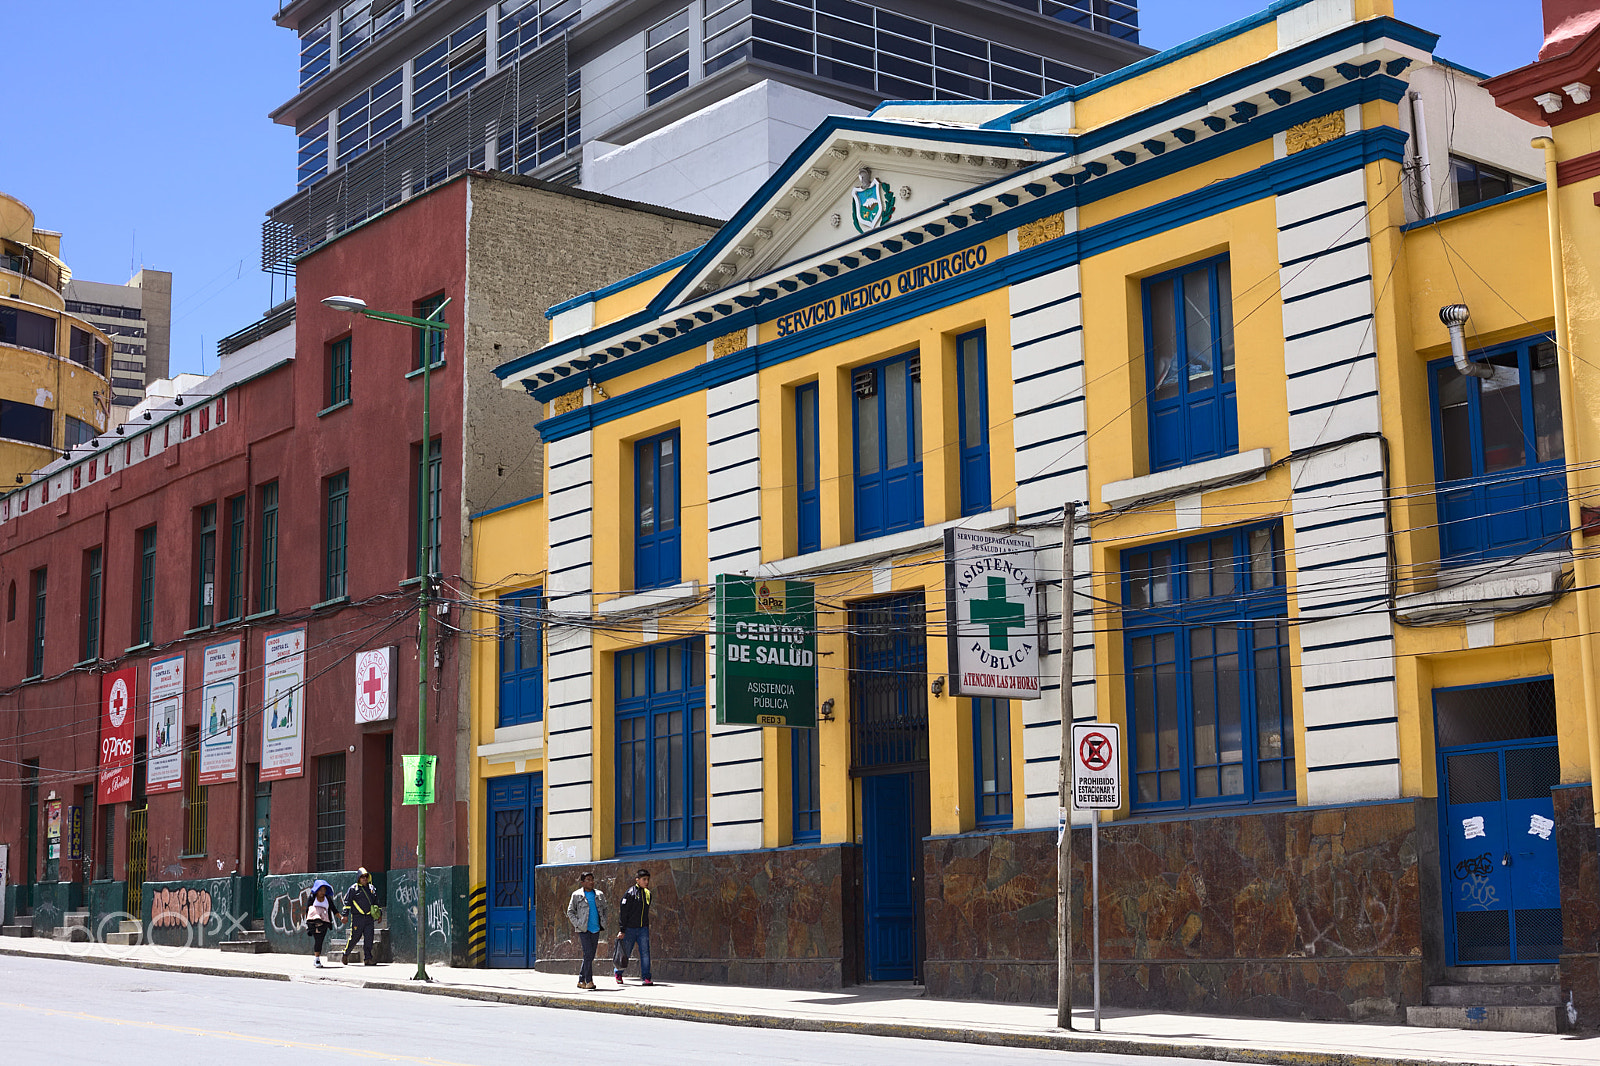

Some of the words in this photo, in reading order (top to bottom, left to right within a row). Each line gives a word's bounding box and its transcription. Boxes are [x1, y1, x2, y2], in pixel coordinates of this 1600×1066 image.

[777, 299, 836, 337] SERVICIO
[840, 280, 891, 315] MEDICO
[897, 245, 987, 293] QUIRURGICO
[73, 397, 225, 490] BOLIVIANA
[957, 533, 984, 542] SERVICIO
[981, 545, 999, 553] SALUD
[958, 557, 1034, 597] ASISTENCIA
[736, 621, 804, 644] CENTRO
[728, 644, 751, 663] DE
[756, 645, 814, 667] SALUD
[971, 640, 1033, 670] PUBLICA
[358, 654, 372, 685] CRUZ
[374, 653, 387, 680] ROJA
[748, 682, 795, 695] ASISTENCIA
[963, 672, 996, 688] ATENCION
[997, 675, 1008, 689] LAS
[1010, 676, 1016, 689] 24
[1017, 676, 1038, 690] HORAS
[359, 691, 387, 718] BOLIVIANA
[753, 695, 789, 709] PÚBLICA
[761, 716, 776, 724] RED
[777, 716, 781, 724] 3
[1078, 786, 1111, 794] ESTACIONAR
[1079, 777, 1115, 786] PROHIBIDO
[1078, 794, 1116, 803] DETENERSE
